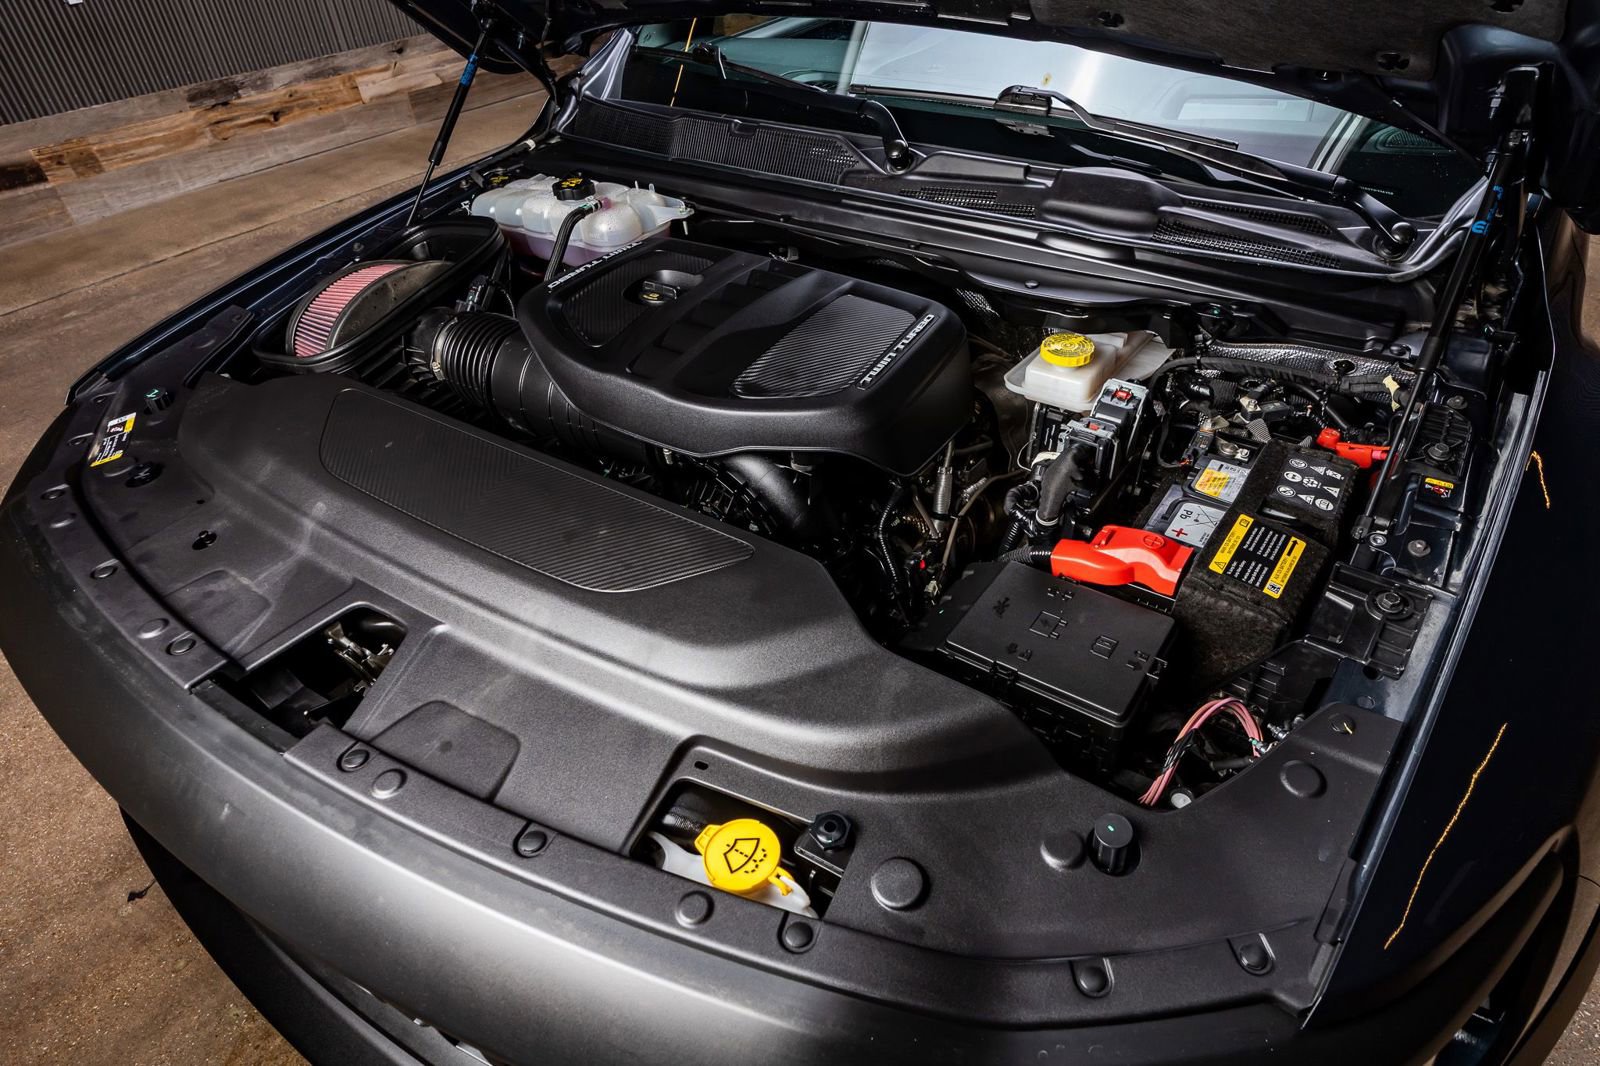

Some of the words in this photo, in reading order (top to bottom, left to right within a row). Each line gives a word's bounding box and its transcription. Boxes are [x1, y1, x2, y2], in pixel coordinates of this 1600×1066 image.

[860, 352, 897, 383] TWIN
[893, 314, 935, 350] TURBO
[1180, 509, 1193, 520] Pb
